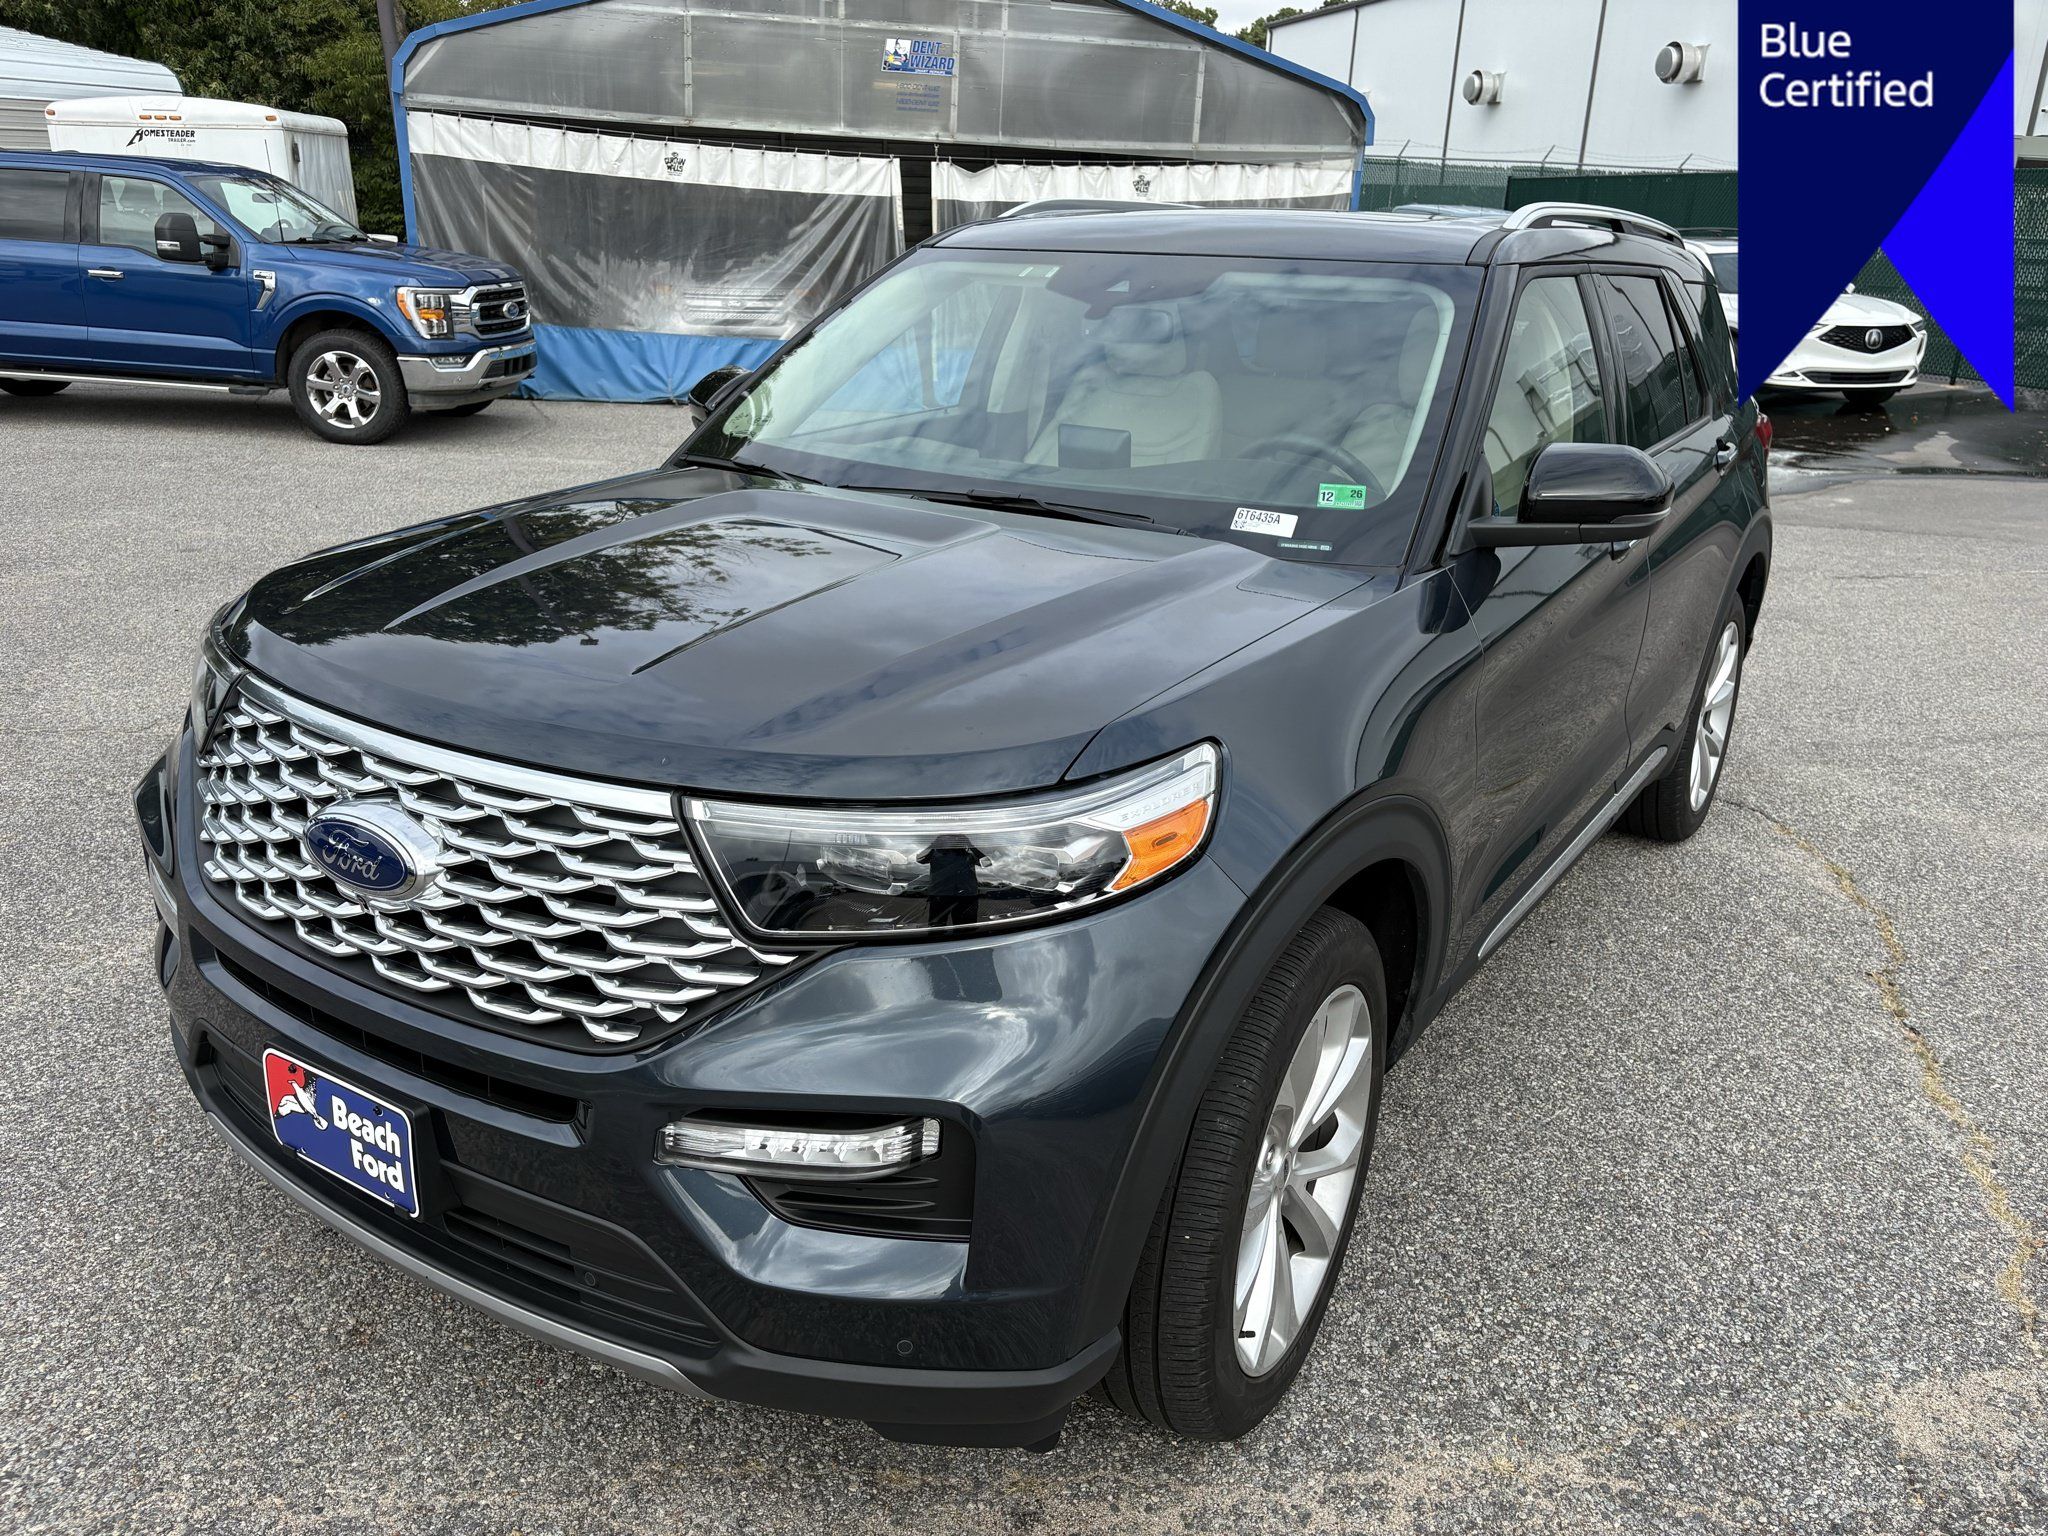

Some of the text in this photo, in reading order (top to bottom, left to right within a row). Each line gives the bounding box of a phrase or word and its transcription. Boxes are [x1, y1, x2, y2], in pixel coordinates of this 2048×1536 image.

[912, 40, 942, 54] DENT
[910, 55, 955, 70] WIZARD
[126, 127, 196, 147] HOMESTEADER
[1320, 491, 1334, 502] 12
[1350, 489, 1363, 499] 26
[1237, 509, 1280, 525] 6T6435A
[322, 829, 384, 881] Ford
[331, 1094, 402, 1158] Beach
[350, 1138, 406, 1194] Ford
